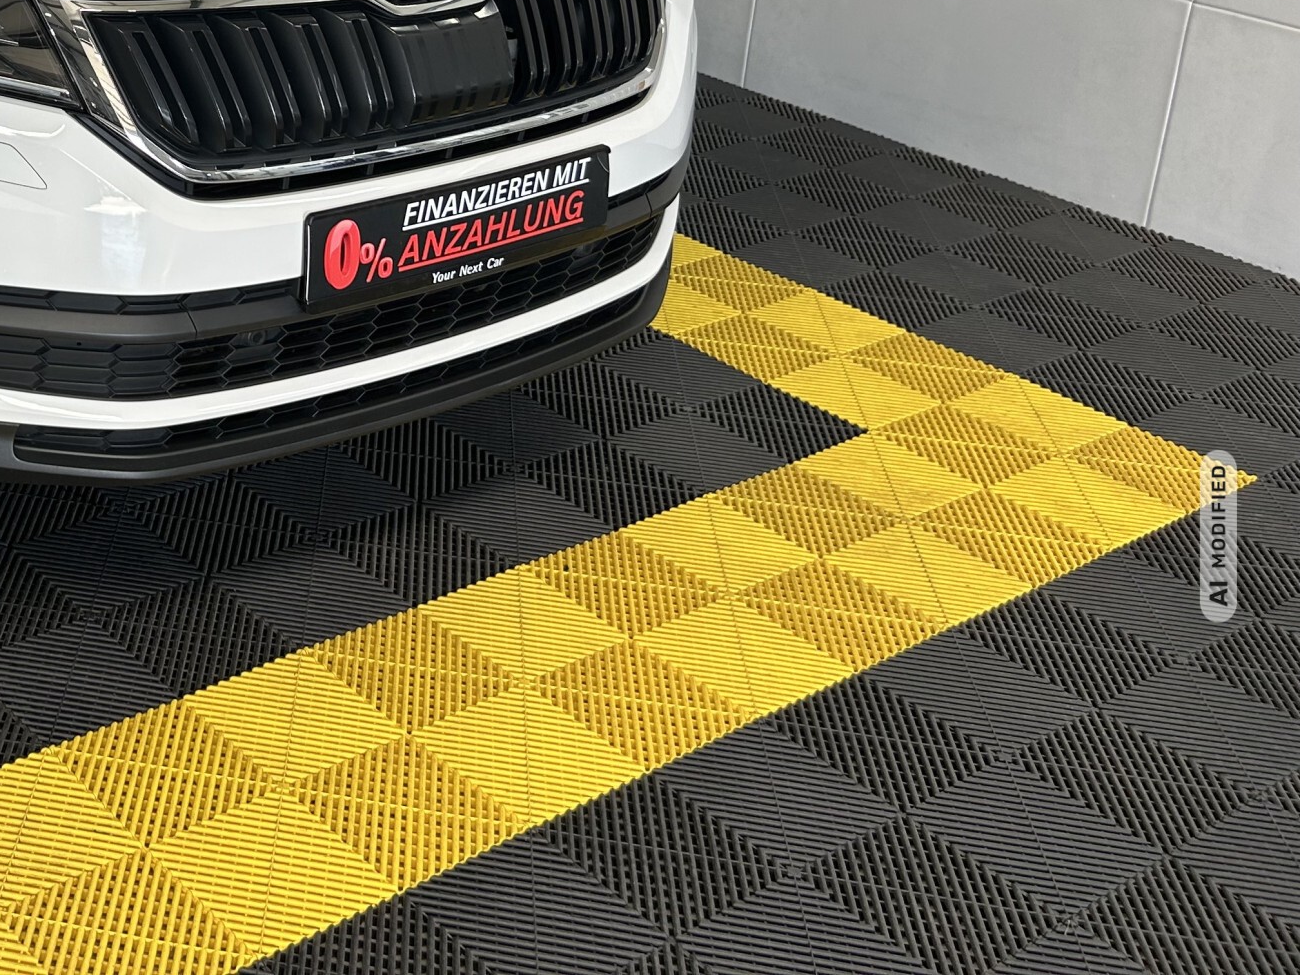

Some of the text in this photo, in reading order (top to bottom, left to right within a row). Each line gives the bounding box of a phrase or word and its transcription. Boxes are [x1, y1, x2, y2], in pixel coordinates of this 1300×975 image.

[402, 157, 592, 227] FINANZIEREN MIT
[324, 190, 585, 290] 0% ANZAHLUNG
[432, 256, 504, 284] Your Next Car
